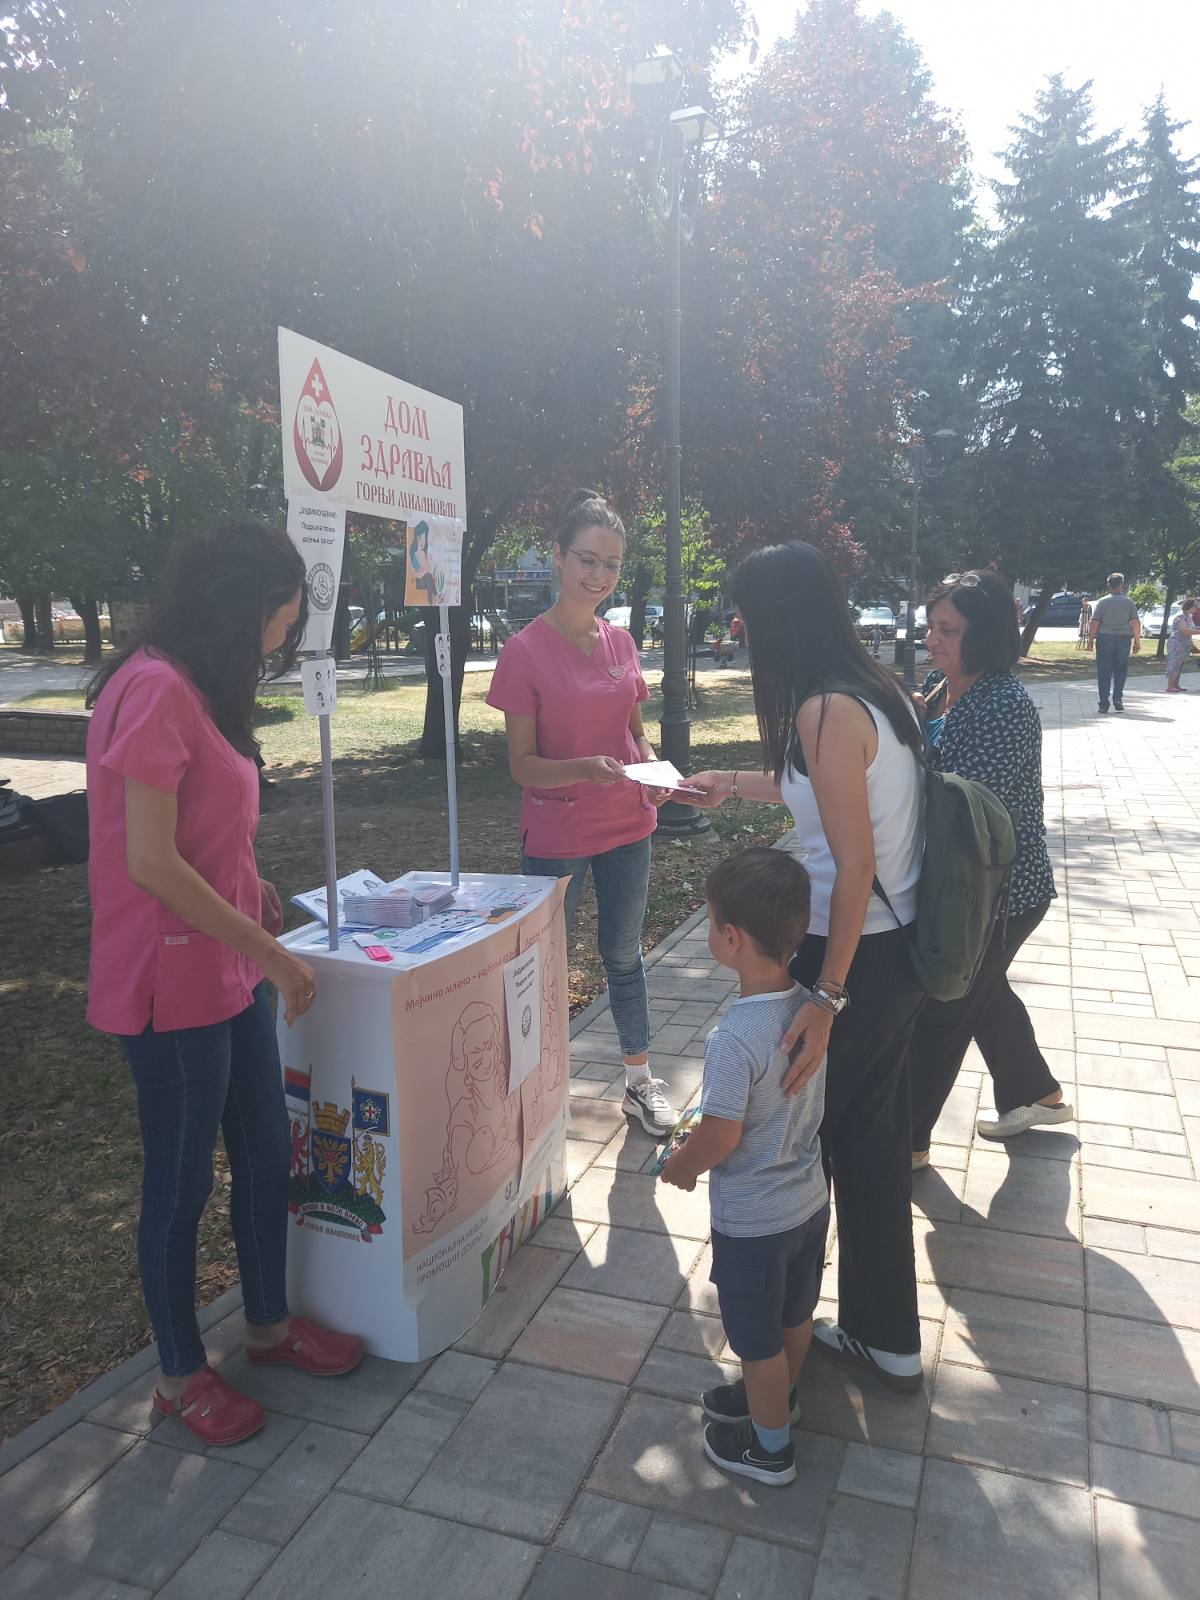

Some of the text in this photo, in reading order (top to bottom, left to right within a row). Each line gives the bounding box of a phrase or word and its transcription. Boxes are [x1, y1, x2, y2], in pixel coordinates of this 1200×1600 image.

[384, 396, 430, 441] ДОМ
[360, 434, 453, 490] ЗДРАВЉА
[356, 481, 457, 519] ГОРЊИ МИЛАНОВАЦ
[405, 987, 444, 1012] Мајчино
[444, 976, 471, 996] млеко
